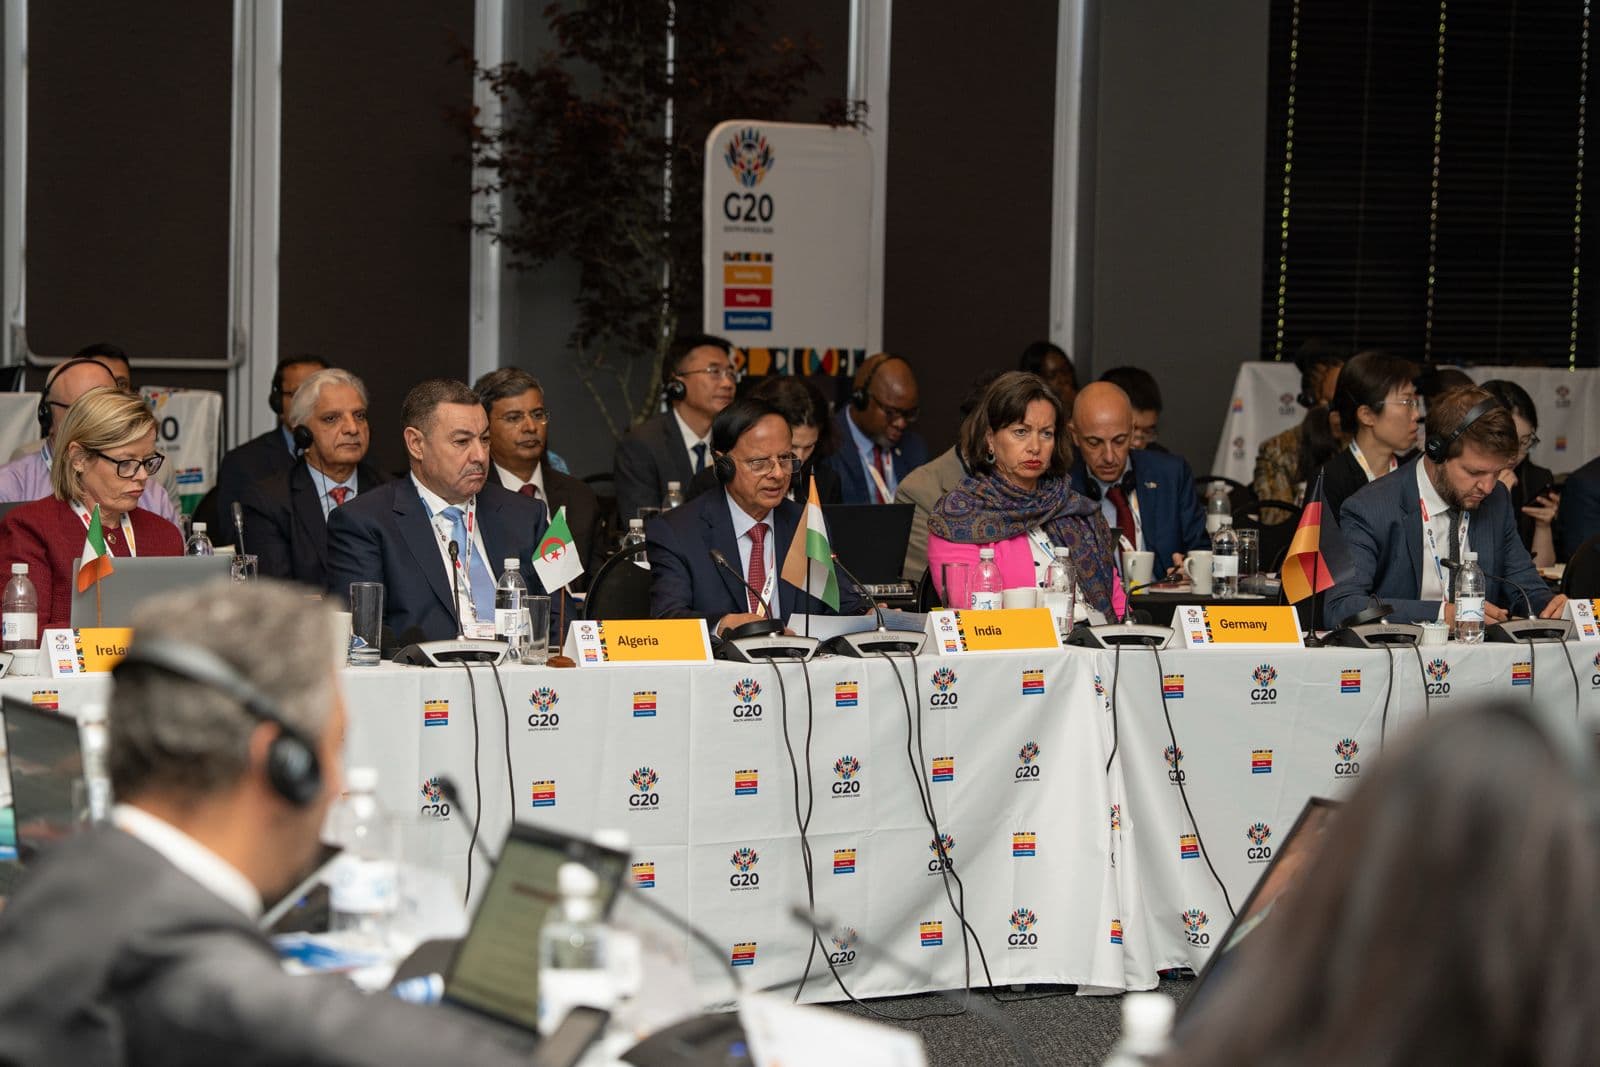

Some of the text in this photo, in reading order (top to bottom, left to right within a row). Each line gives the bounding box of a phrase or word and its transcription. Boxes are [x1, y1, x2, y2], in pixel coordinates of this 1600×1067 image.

[724, 192, 774, 222] G20
[974, 625, 1002, 636] India
[1219, 618, 1267, 631] Germany
[618, 635, 659, 649] Algeria
[95, 644, 129, 656] Irela
[1250, 688, 1277, 701] G20
[1427, 682, 1450, 695] G20
[930, 693, 958, 706] G20
[733, 704, 762, 718] G20
[528, 713, 559, 727] G20
[1015, 765, 1040, 779] G20
[1335, 763, 1360, 775] G20
[832, 781, 860, 794] G20
[629, 793, 660, 807] G20
[1247, 847, 1270, 860] G20
[730, 873, 760, 887] G20
[1008, 933, 1038, 946] G20
[830, 951, 855, 964] G20
